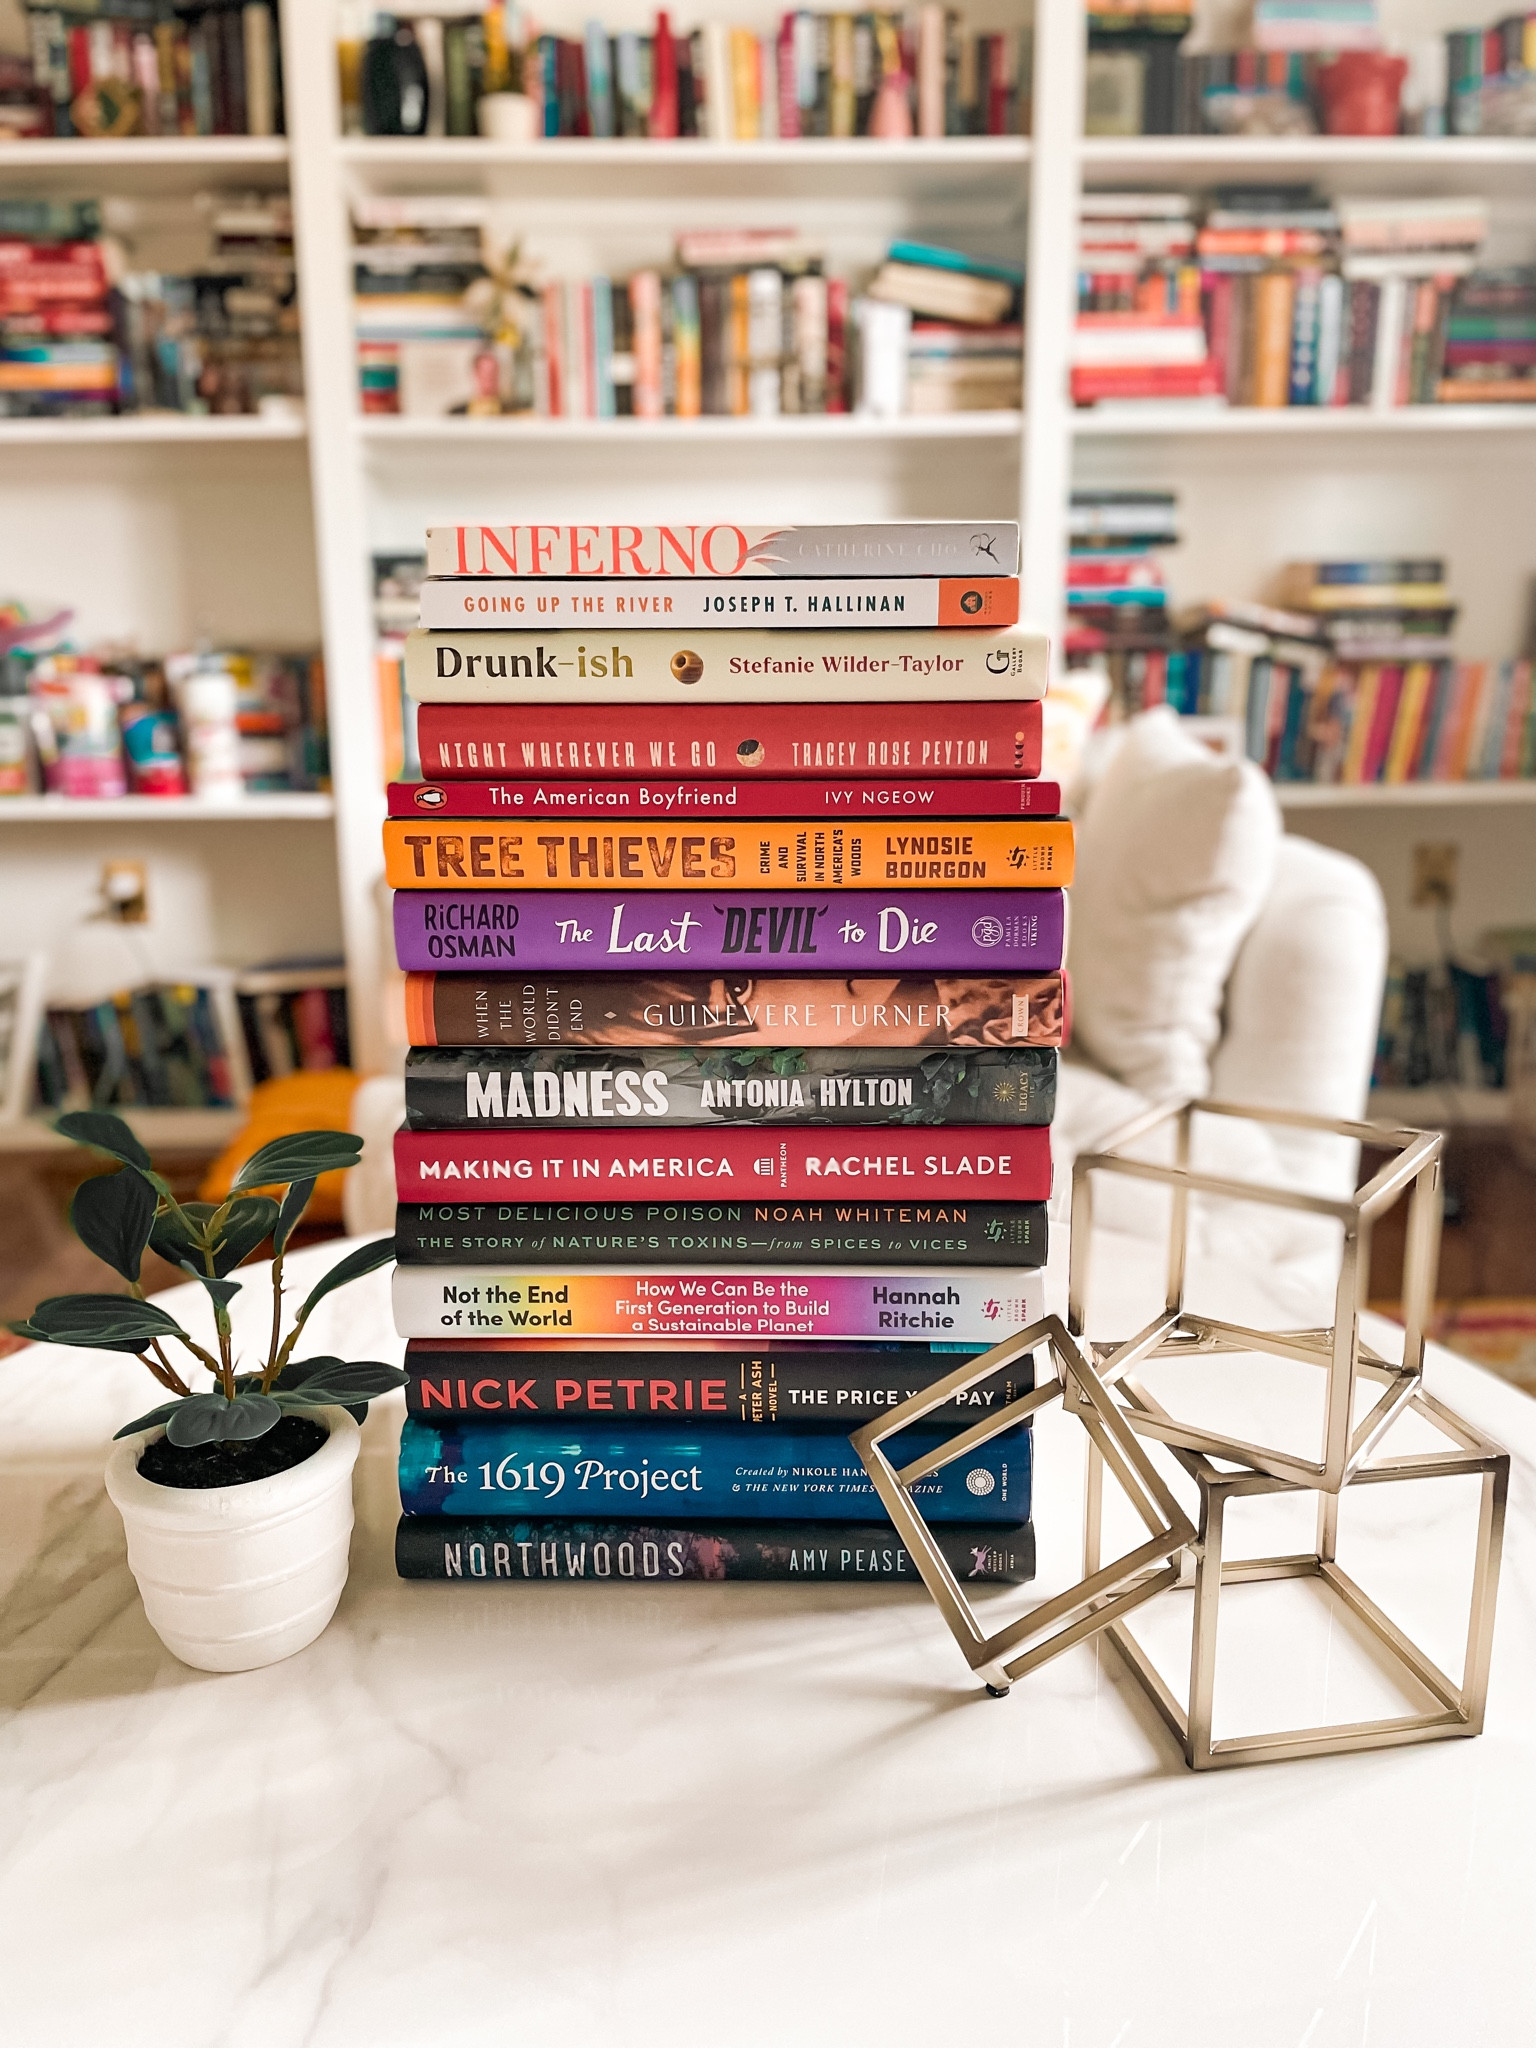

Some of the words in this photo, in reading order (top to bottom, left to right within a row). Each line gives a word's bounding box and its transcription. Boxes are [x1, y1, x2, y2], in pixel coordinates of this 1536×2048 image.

[453, 525, 749, 575] INFERNO
[463, 596, 526, 613] GOING
[537, 596, 560, 613] UP
[571, 596, 605, 613] THE
[616, 596, 674, 613] RIVER
[703, 595, 775, 613] JOSEPH
[784, 595, 797, 612] T.
[807, 594, 906, 612] HALLINAN
[436, 645, 634, 678] Drunk-ish
[729, 655, 815, 675] Stefanie
[821, 655, 964, 676] Wilder-Taylor
[438, 742, 507, 768] NIGHT
[521, 741, 635, 768] WHEREVER
[649, 741, 677, 767] WE
[691, 740, 717, 767] GO
[791, 741, 857, 767] TRACEY
[867, 740, 911, 767] ROSE
[921, 739, 989, 766] PEYTON
[488, 787, 525, 805] The
[533, 787, 630, 805] American
[638, 786, 737, 810] Boyfriend
[825, 790, 854, 805] IVY
[861, 790, 935, 805] NGEOW
[404, 835, 525, 878] TREE
[537, 836, 736, 878] THIEVES
[760, 840, 771, 875] CRIME
[778, 846, 789, 870] AND
[796, 831, 807, 883] SURVIVAL
[814, 832, 825, 867] NORTH
[832, 829, 844, 885] AMERICA'S
[851, 838, 862, 877] WOODS
[886, 836, 973, 856] LYNDSIE
[815, 867, 825, 883] IN
[886, 861, 986, 879] BOURGON
[554, 919, 594, 944] The
[605, 902, 703, 954] Last
[719, 905, 821, 954] DEVIL
[837, 918, 867, 944] to
[877, 906, 939, 953] Die
[1030, 915, 1038, 947] VIKING
[427, 935, 517, 959] OSMAN
[476, 989, 488, 1039] WHEN
[500, 999, 512, 1030] THE
[522, 984, 536, 1043] WORLD
[548, 987, 561, 1041] DIDN'T
[570, 998, 584, 1031] END
[643, 1003, 818, 1027] GUINEVERE
[830, 1003, 952, 1027] TURNER
[466, 1070, 670, 1118] MADNESS
[700, 1078, 805, 1108] ANTONIA
[820, 1078, 913, 1108] HYLTON
[1018, 1070, 1028, 1112] LEGACY
[419, 1159, 533, 1180] MAKING
[542, 1159, 564, 1178] IT
[572, 1159, 600, 1178] IN
[608, 1157, 735, 1178] AMERICA
[805, 1156, 915, 1176] RACHEL
[924, 1155, 1012, 1175] SLADE
[418, 1206, 487, 1221] MOST
[498, 1206, 634, 1221] DELICIOUS
[646, 1206, 742, 1222] POISON
[754, 1207, 823, 1223] NOAH
[834, 1207, 968, 1224] WHITEMAN
[417, 1236, 454, 1248] THE
[461, 1236, 525, 1248] STORY
[531, 1236, 547, 1251] of
[552, 1236, 660, 1248] NATURE'S
[810, 1238, 882, 1250] SPICES
[888, 1240, 902, 1250] to
[909, 1239, 968, 1250] VICES
[443, 1285, 481, 1304] Not
[485, 1285, 522, 1304] the
[527, 1285, 569, 1304] End
[635, 1280, 676, 1297] How
[678, 1280, 707, 1297] We
[711, 1280, 748, 1297] Can
[752, 1281, 775, 1297] Be
[779, 1281, 809, 1297] the
[872, 1286, 961, 1305] Hannah
[440, 1310, 464, 1326] of
[467, 1310, 504, 1326] the
[507, 1310, 573, 1326] World
[615, 1300, 653, 1315] First
[657, 1300, 759, 1315] Generation
[762, 1301, 781, 1316] to
[785, 1300, 830, 1316] Build
[878, 1311, 955, 1329] Ritchie
[631, 1321, 644, 1332] a
[647, 1319, 752, 1332] Sustainable
[757, 1319, 815, 1333] Planet
[751, 1360, 762, 1388] ASH
[419, 1379, 540, 1410] NICK
[555, 1379, 728, 1411] PETRIE
[738, 1393, 747, 1401] A
[768, 1380, 778, 1412] NOVEL
[788, 1389, 829, 1405] THE
[836, 1390, 899, 1406] PRICE
[955, 1390, 995, 1406] PAY
[424, 1466, 469, 1484] The
[477, 1451, 566, 1499] 1619
[573, 1458, 704, 1499] Project
[735, 1466, 774, 1477] Created
[777, 1467, 789, 1479] by
[792, 1467, 838, 1477] NIKOLE
[731, 1483, 741, 1492] &
[745, 1483, 769, 1492] THE
[772, 1483, 800, 1493] NEW
[803, 1484, 835, 1493] YORK
[839, 1484, 876, 1493] TIMES
[444, 1541, 685, 1577] NORTHWOODS
[789, 1549, 828, 1572] AMY
[841, 1549, 907, 1573] PEASE
